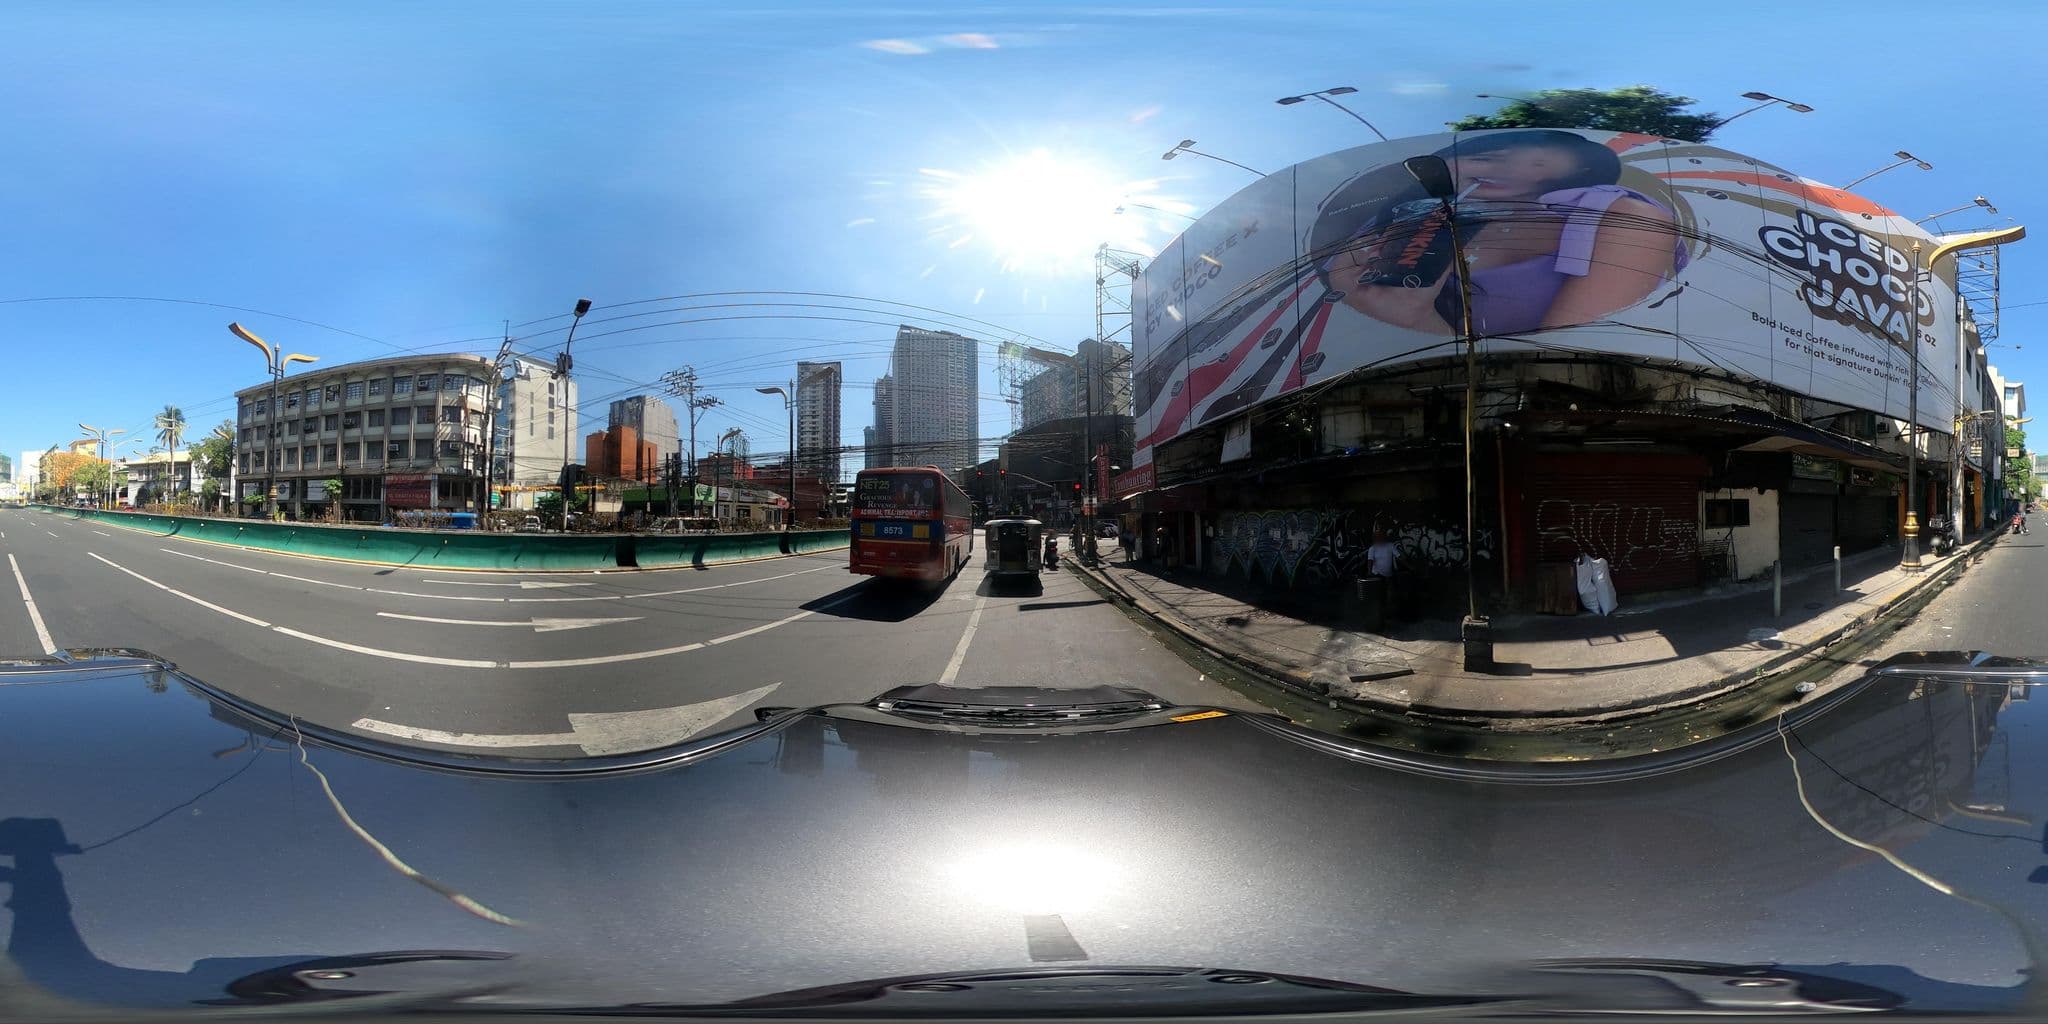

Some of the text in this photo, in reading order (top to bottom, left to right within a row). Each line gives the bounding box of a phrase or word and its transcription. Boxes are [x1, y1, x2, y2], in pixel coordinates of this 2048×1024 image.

[1801, 212, 1909, 273] ICED
[1764, 229, 1931, 317] CHOCO
[1806, 279, 1912, 341] JAVA
[1751, 311, 1776, 328] Bold
[1780, 322, 1802, 337] Iced
[1805, 332, 1840, 350] Coffee
[1842, 344, 1875, 362] infused
[1878, 359, 1894, 369] with
[1785, 338, 1800, 350] for
[1803, 345, 1825, 359] that
[1828, 354, 1872, 374] signature
[1874, 367, 1902, 384] Dunkin'
[884, 526, 903, 535] 8573
